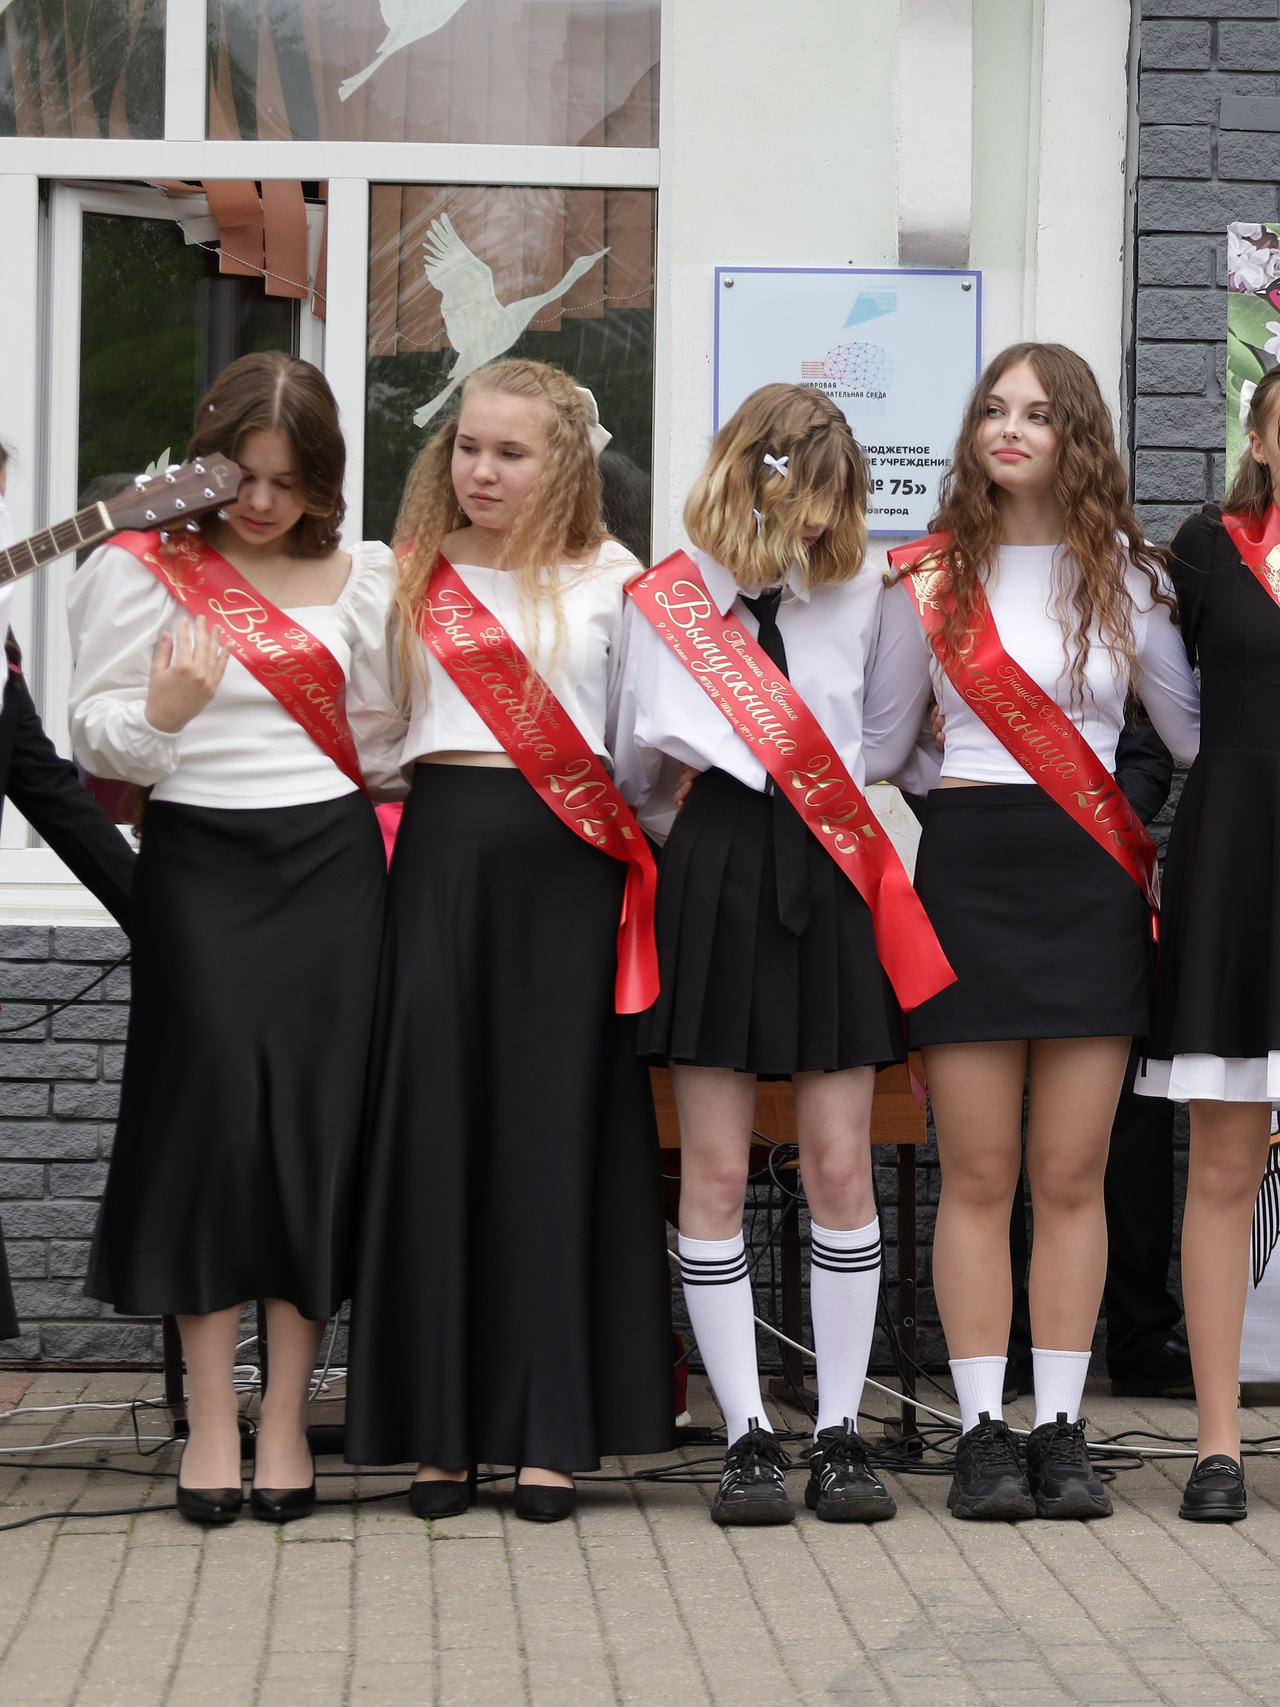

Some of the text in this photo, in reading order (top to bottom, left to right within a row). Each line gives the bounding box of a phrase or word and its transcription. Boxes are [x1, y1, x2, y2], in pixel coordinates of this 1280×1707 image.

[866, 391, 887, 400] СРЕДА
[861, 445, 930, 455] БЮДЖЕТНОЕ
[880, 458, 951, 468] УЧРЕЖДЕНИЕ
[890, 479, 927, 496] 75»
[867, 507, 909, 517] овгород
[425, 589, 557, 761] Выпускница
[760, 676, 799, 722] Ксения
[654, 579, 879, 855] Выпускница 2025
[1038, 704, 1068, 738] Олеся
